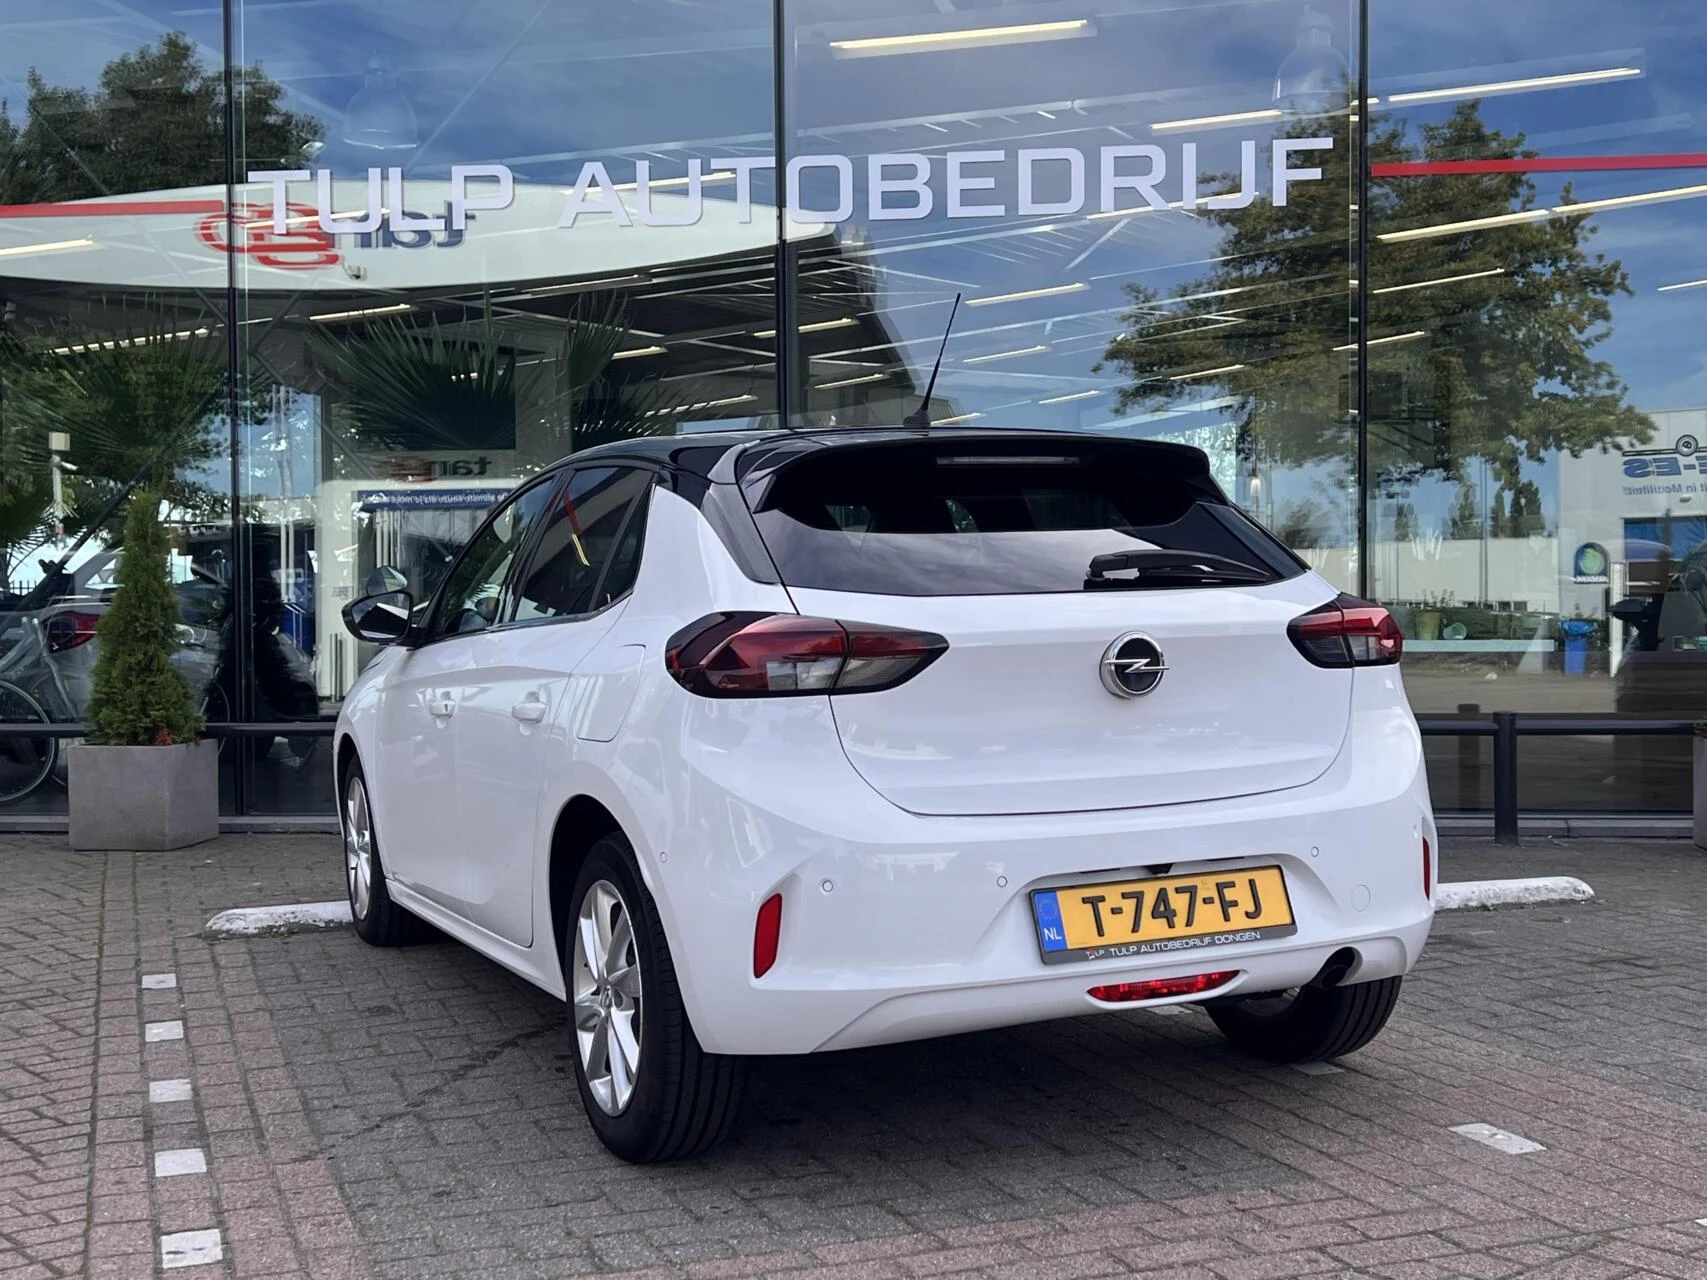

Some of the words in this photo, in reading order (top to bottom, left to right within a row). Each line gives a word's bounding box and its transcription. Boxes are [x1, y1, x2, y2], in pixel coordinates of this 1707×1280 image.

[247, 165, 514, 235] TULP
[558, 137, 1334, 229] AUTOBEDRIJF
[1081, 878, 1263, 937] T-747-FJ
[1043, 927, 1062, 941] NL
[1108, 944, 1138, 957] TULP
[1140, 938, 1213, 953] AUTOBEDRIJF
[1215, 931, 1261, 945] DONGEN
